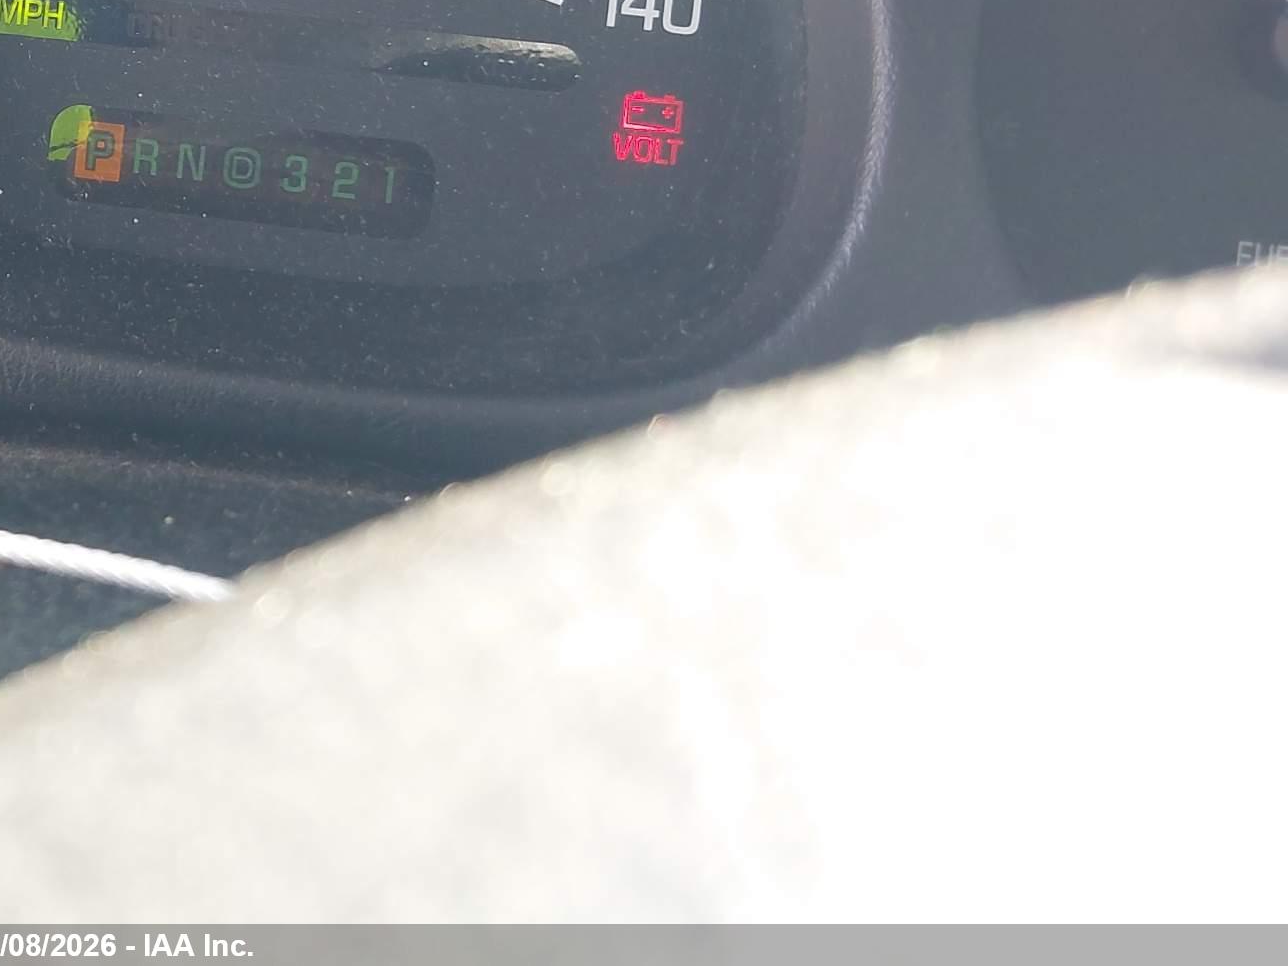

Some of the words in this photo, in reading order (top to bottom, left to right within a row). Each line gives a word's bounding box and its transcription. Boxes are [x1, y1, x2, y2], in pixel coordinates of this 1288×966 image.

[86, 131, 116, 171] P
[133, 138, 159, 176] R
[176, 143, 206, 181] N
[283, 154, 309, 193] 3
[331, 161, 360, 200] 2
[384, 166, 396, 204] 1
[613, 132, 683, 166] VOLT
